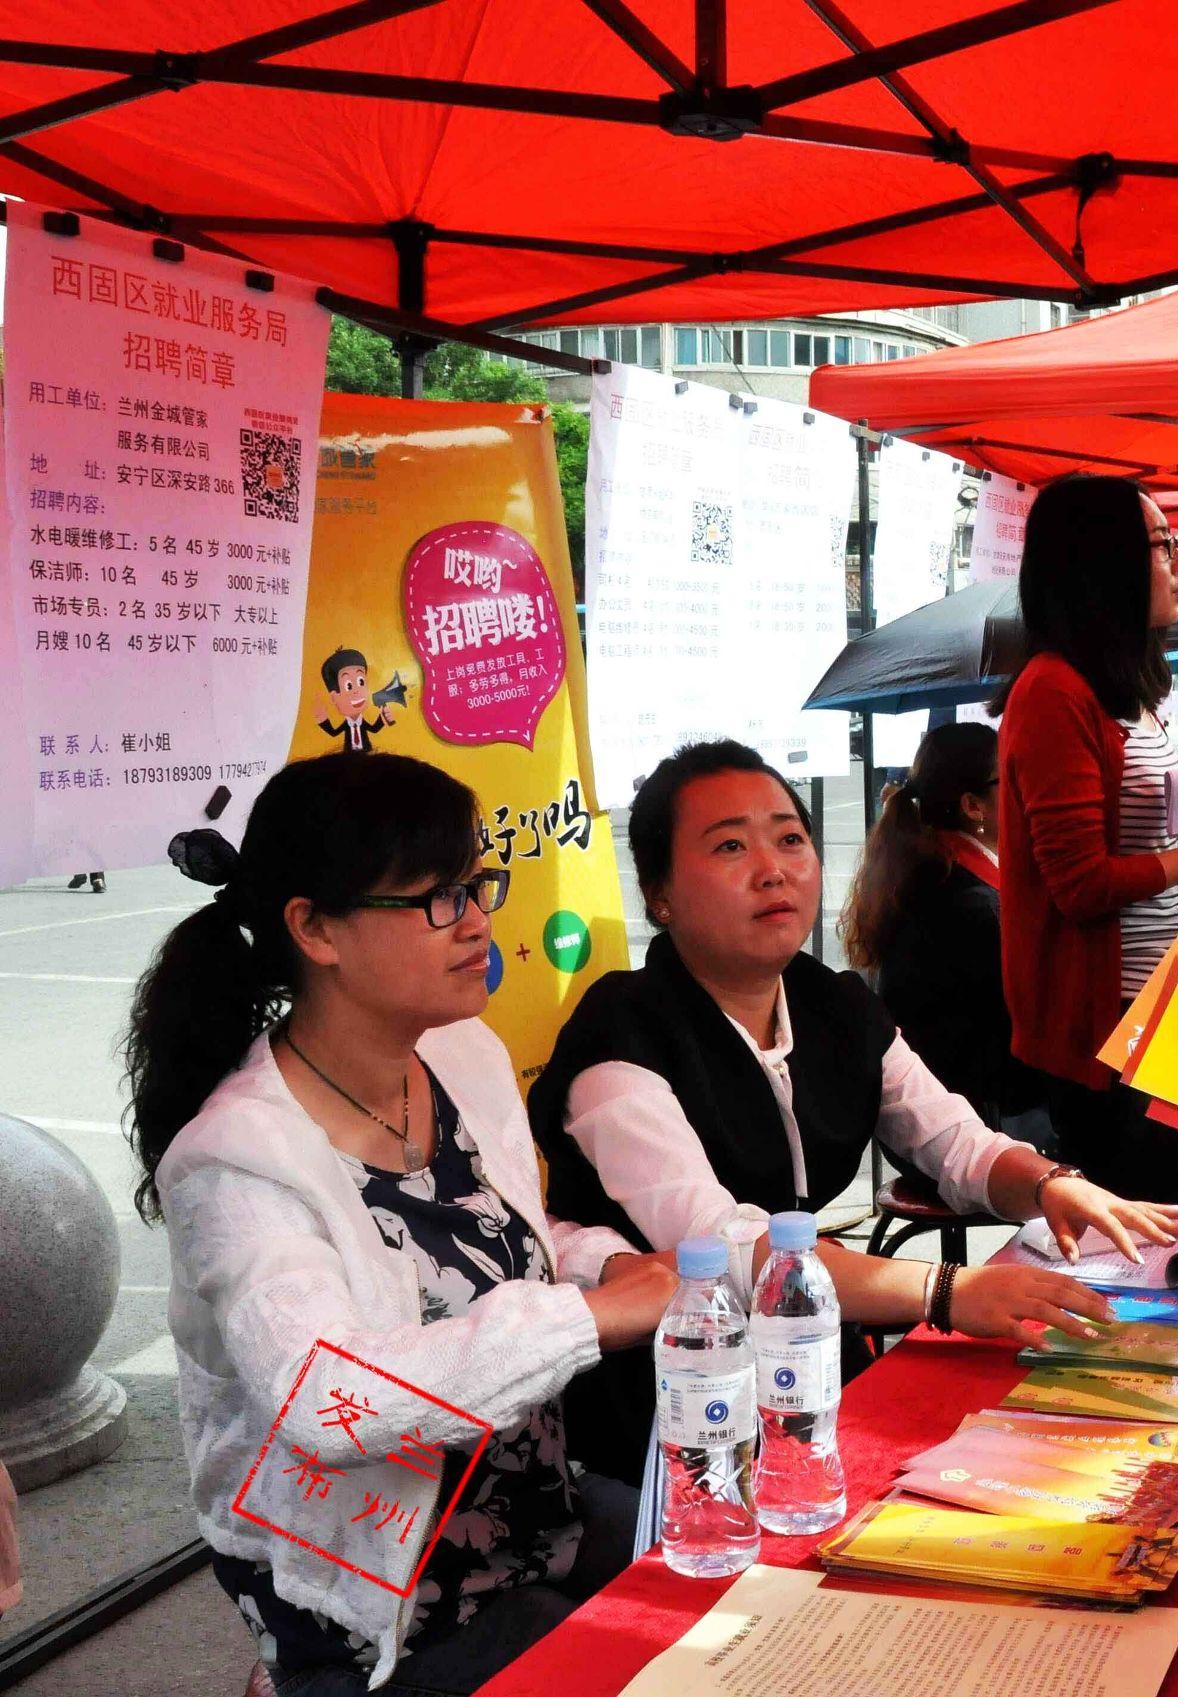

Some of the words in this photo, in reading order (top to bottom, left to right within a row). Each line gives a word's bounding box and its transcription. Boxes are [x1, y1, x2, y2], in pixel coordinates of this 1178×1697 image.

[51, 255, 288, 348] 西固区就业服务局
[123, 331, 235, 389] 招聘简章
[28, 381, 107, 412] 用工单位:
[117, 396, 208, 429] 兰州金城管家
[117, 430, 210, 462] 服务有限公司
[29, 489, 106, 515] 招聘内容:
[233, 604, 278, 626] 大专以上
[422, 592, 549, 657] 招聘喽!
[120, 733, 171, 753] 崔小姐
[39, 768, 111, 791] 联系电话:
[123, 764, 212, 785] 18793189309
[769, 1395, 804, 1406] 兰州银行
[698, 1427, 736, 1440] 兰州银行
